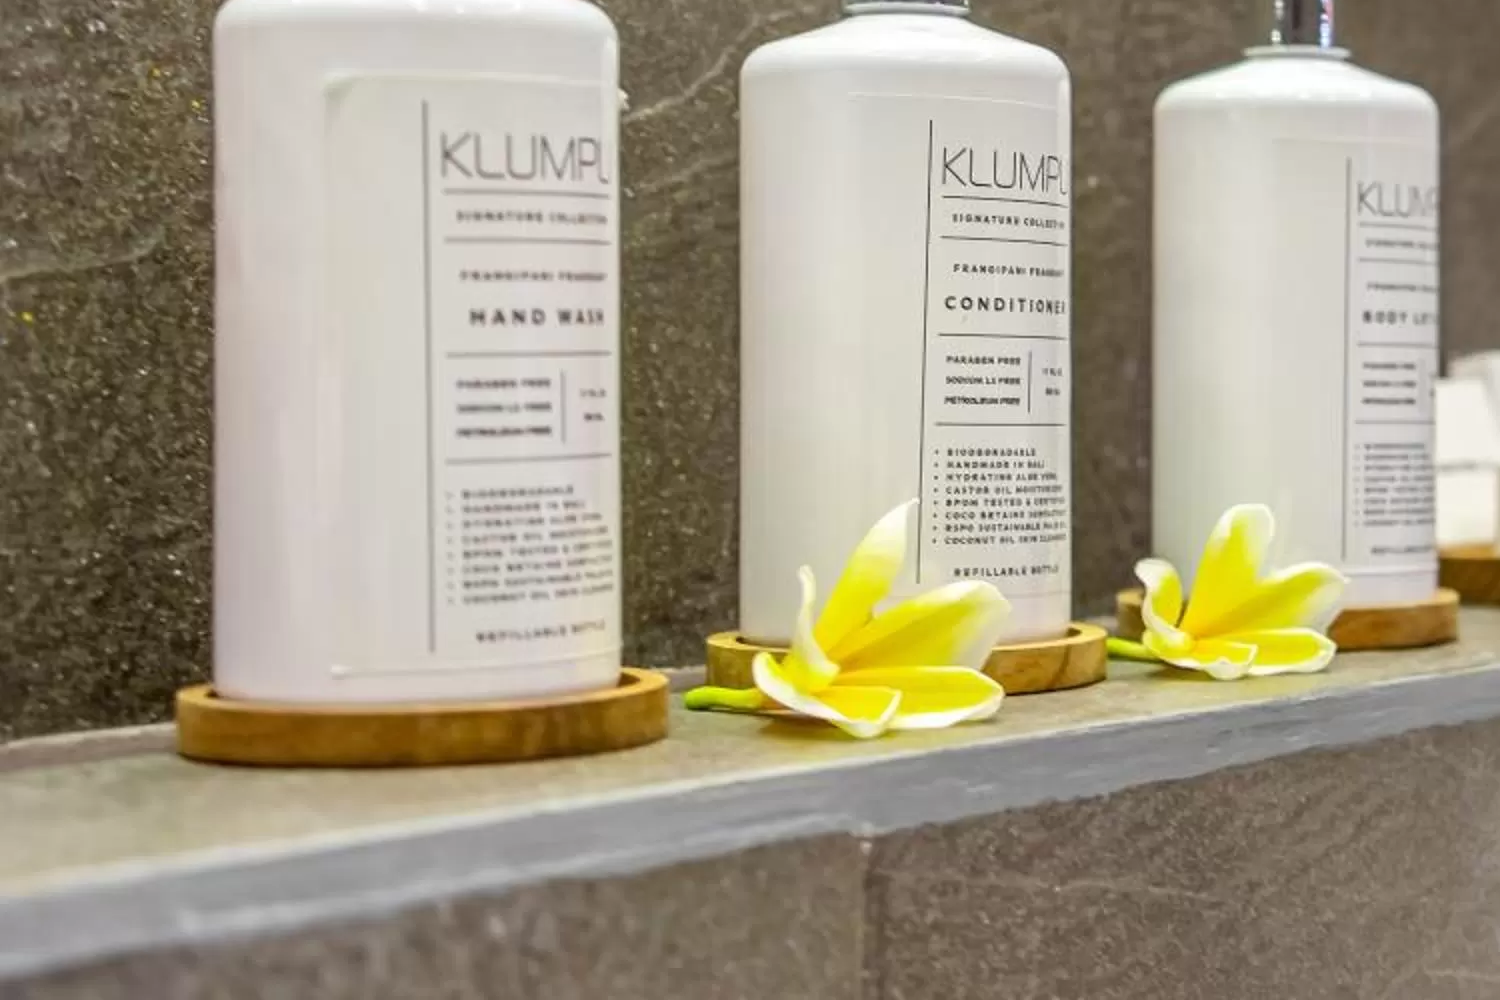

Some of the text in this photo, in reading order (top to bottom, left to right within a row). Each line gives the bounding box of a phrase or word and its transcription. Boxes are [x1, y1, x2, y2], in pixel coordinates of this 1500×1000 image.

[952, 212, 1020, 227] SIGNATURE
[953, 262, 1027, 276] FRANGIPANI
[468, 307, 546, 327] HAND
[945, 355, 995, 367] PARABEN
